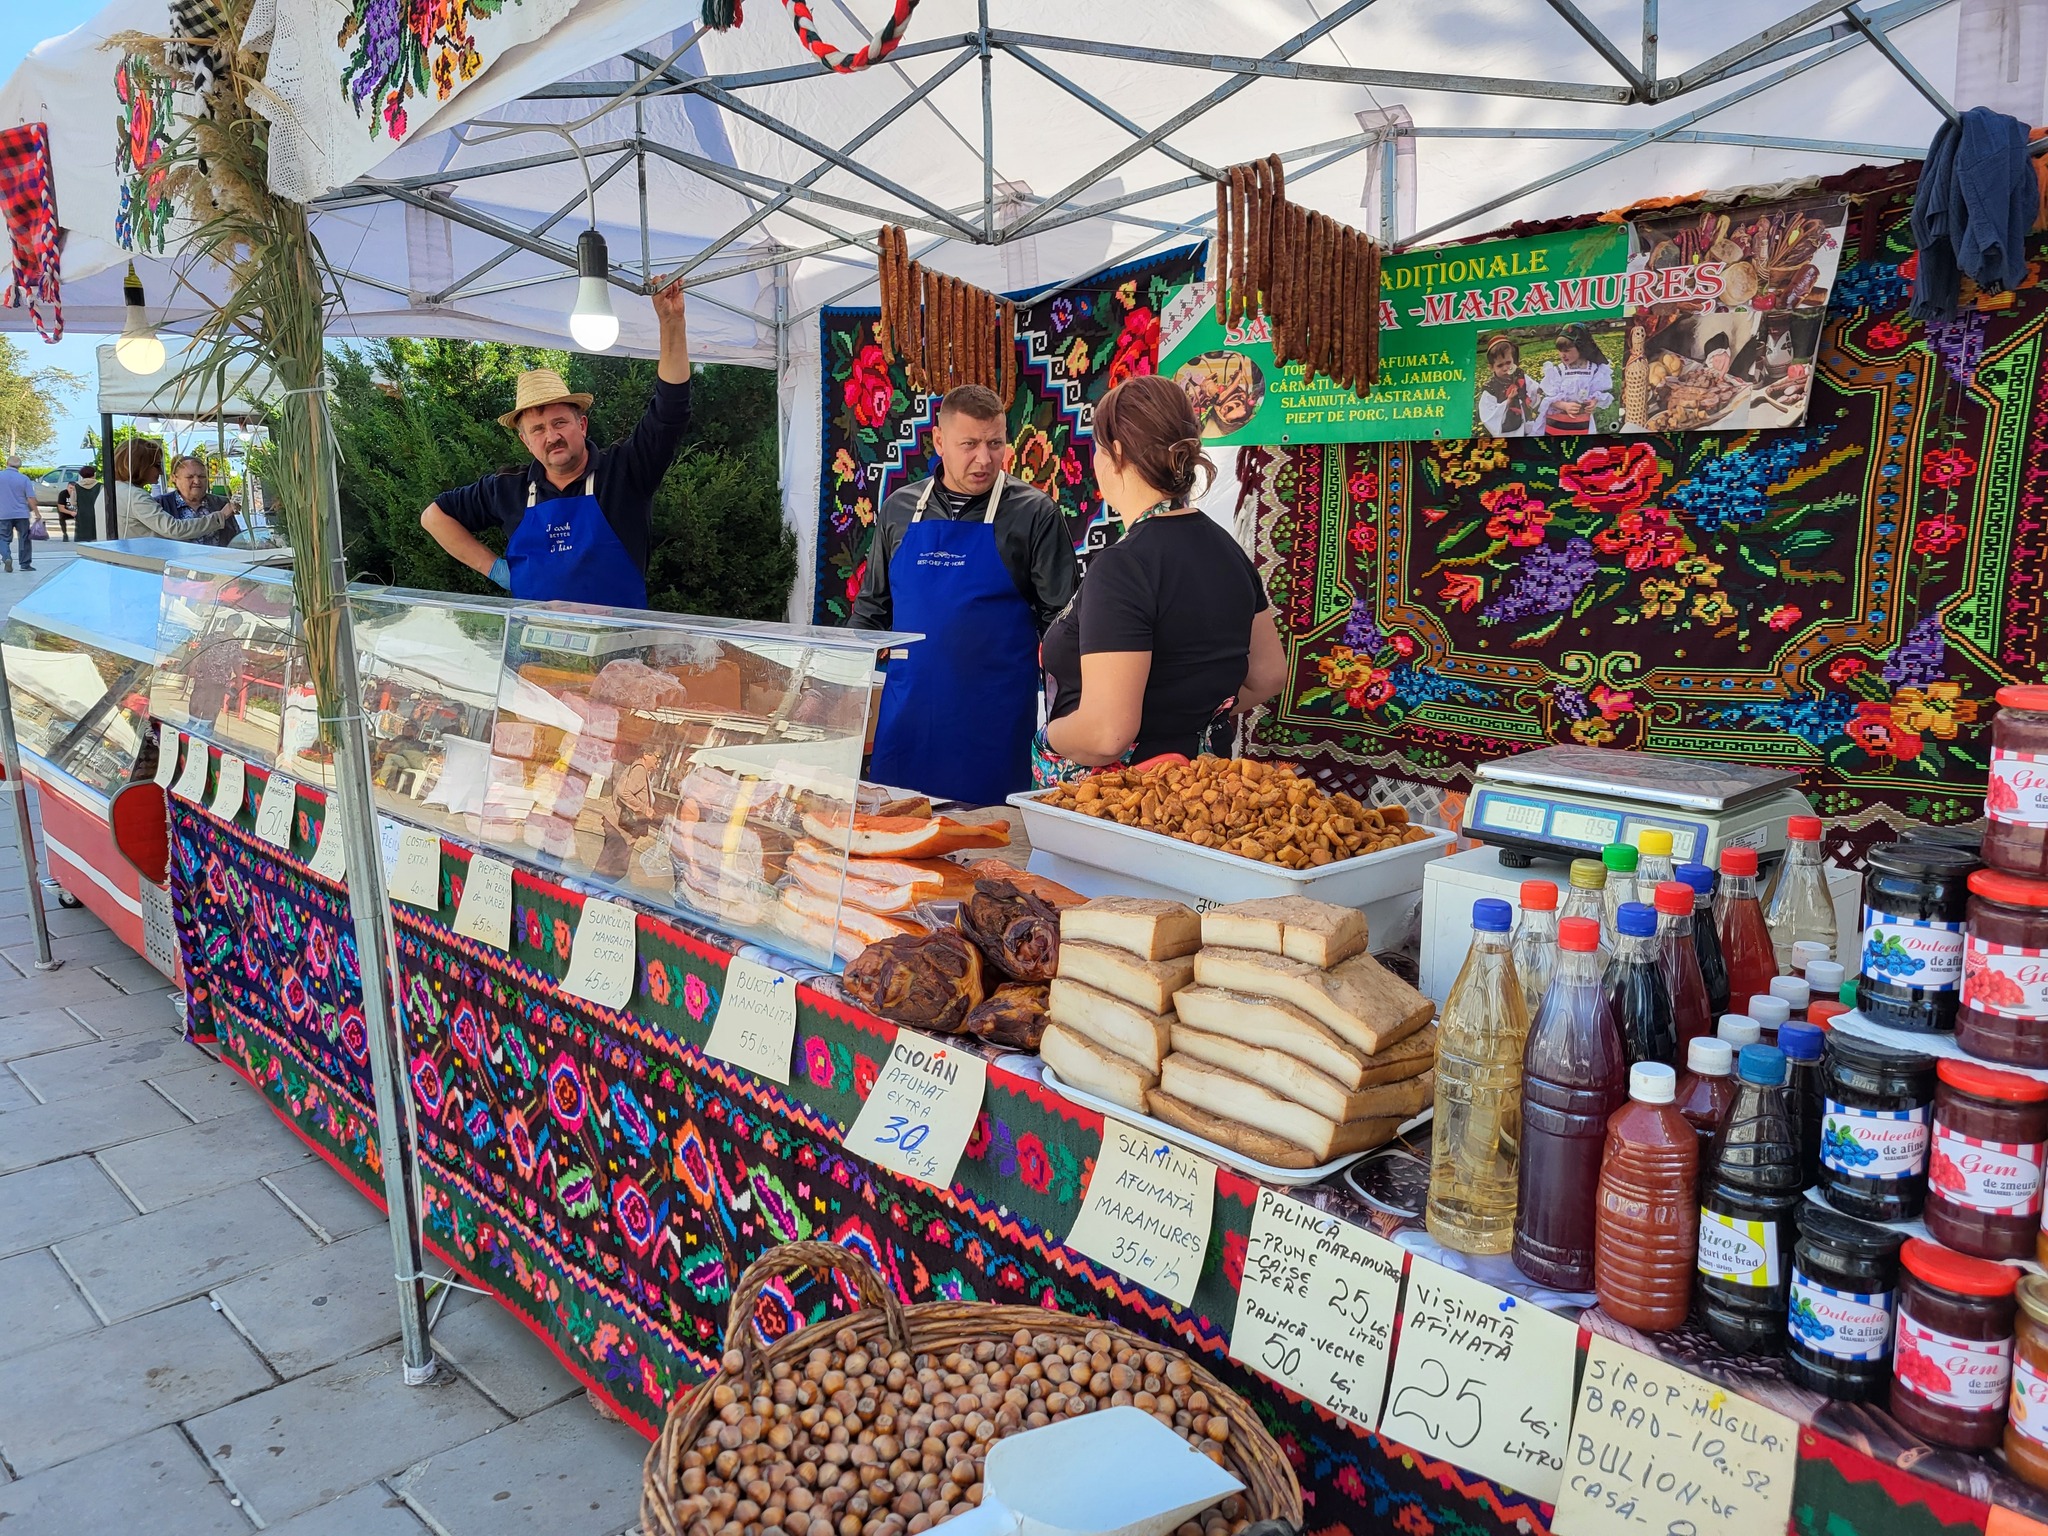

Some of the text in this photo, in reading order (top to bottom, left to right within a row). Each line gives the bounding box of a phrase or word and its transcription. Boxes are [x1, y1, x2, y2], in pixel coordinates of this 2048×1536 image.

[1380, 249, 1549, 294] ADIȚIONALE
[1401, 369, 1467, 385] JAMBON,
[1286, 405, 1445, 425] PIEPT DE PORC, LABĂR
[2010, 769, 2048, 791] Ge
[593, 947, 625, 964] EXTRA
[1930, 955, 1944, 967] de
[2012, 964, 2048, 986] Ge
[887, 1090, 931, 1118] EXTRA
[874, 1116, 930, 1151] 30
[1882, 1141, 1924, 1155] de afine
[1957, 1153, 2019, 1177] Gem
[1982, 1177, 2037, 1192] de zmeură
[1721, 1252, 1733, 1262] de
[1735, 1255, 1758, 1268] brad
[1838, 1325, 1884, 1337] de afine
[1942, 1355, 2000, 1376] Gem
[1968, 1378, 1982, 1388] de
[1392, 1358, 1487, 1448] 25
